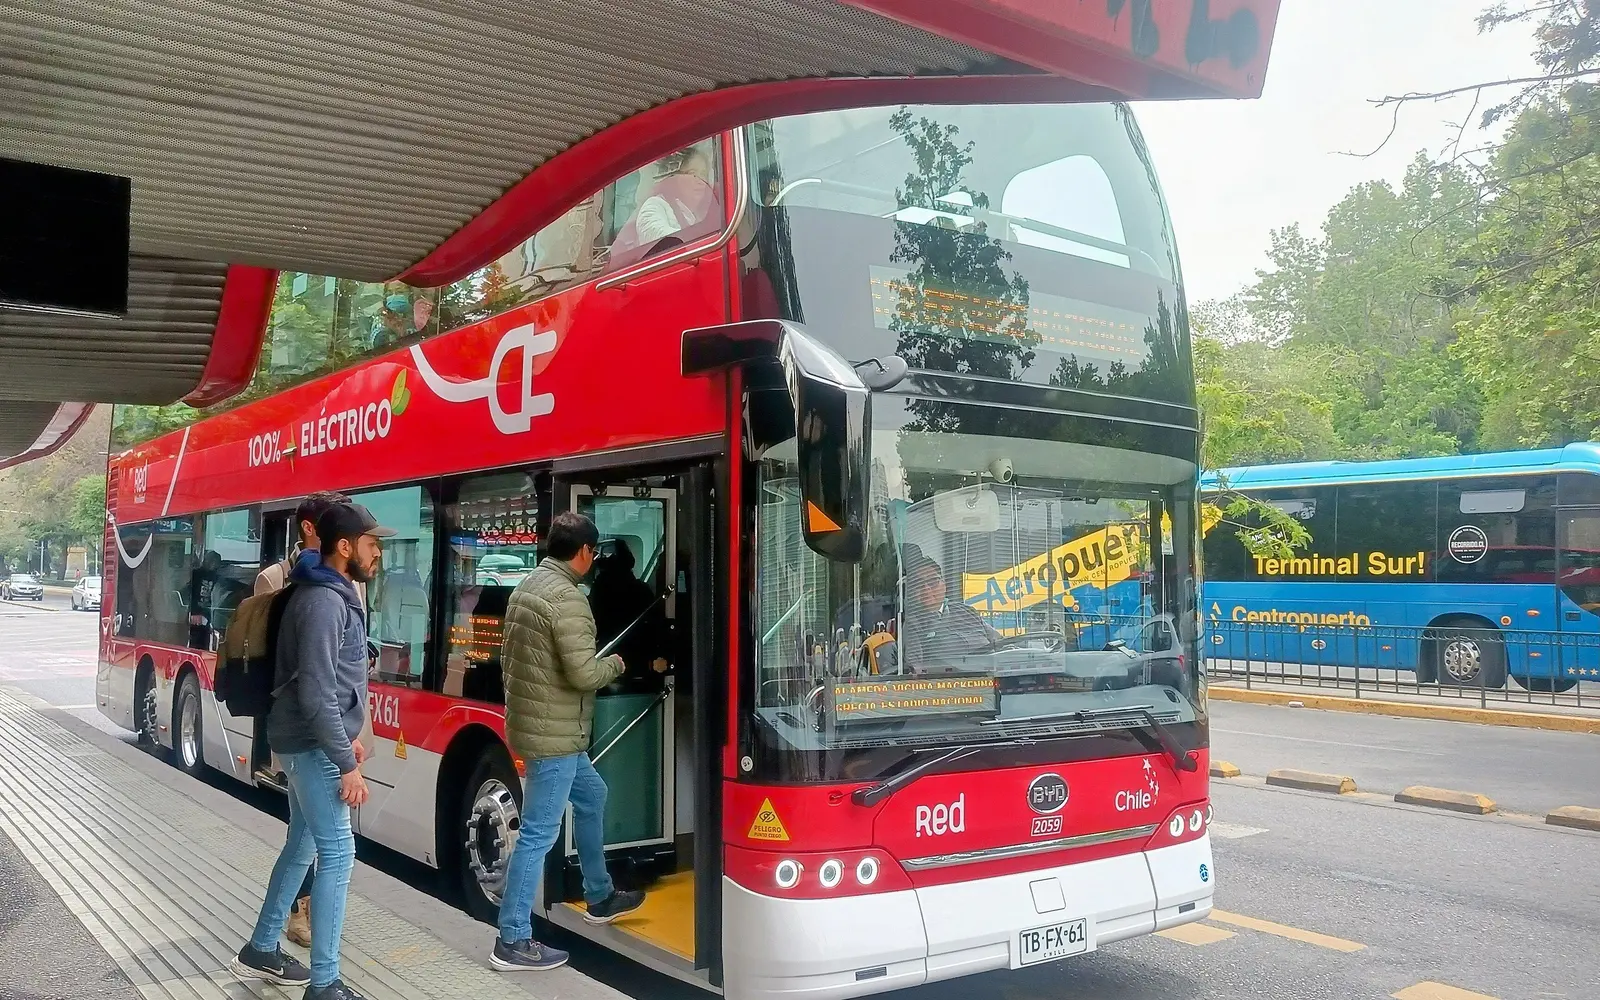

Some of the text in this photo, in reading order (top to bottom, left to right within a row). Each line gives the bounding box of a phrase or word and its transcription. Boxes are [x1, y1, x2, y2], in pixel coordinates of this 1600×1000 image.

[248, 398, 392, 468] 100% ELÉCTRICO
[1253, 552, 1425, 575] Terminal Sur!
[1033, 785, 1065, 804] BYD
[1115, 789, 1151, 811] Chile
[916, 792, 966, 838] Red
[1033, 818, 1061, 834] 2059
[754, 825, 782, 833] PELIGRO
